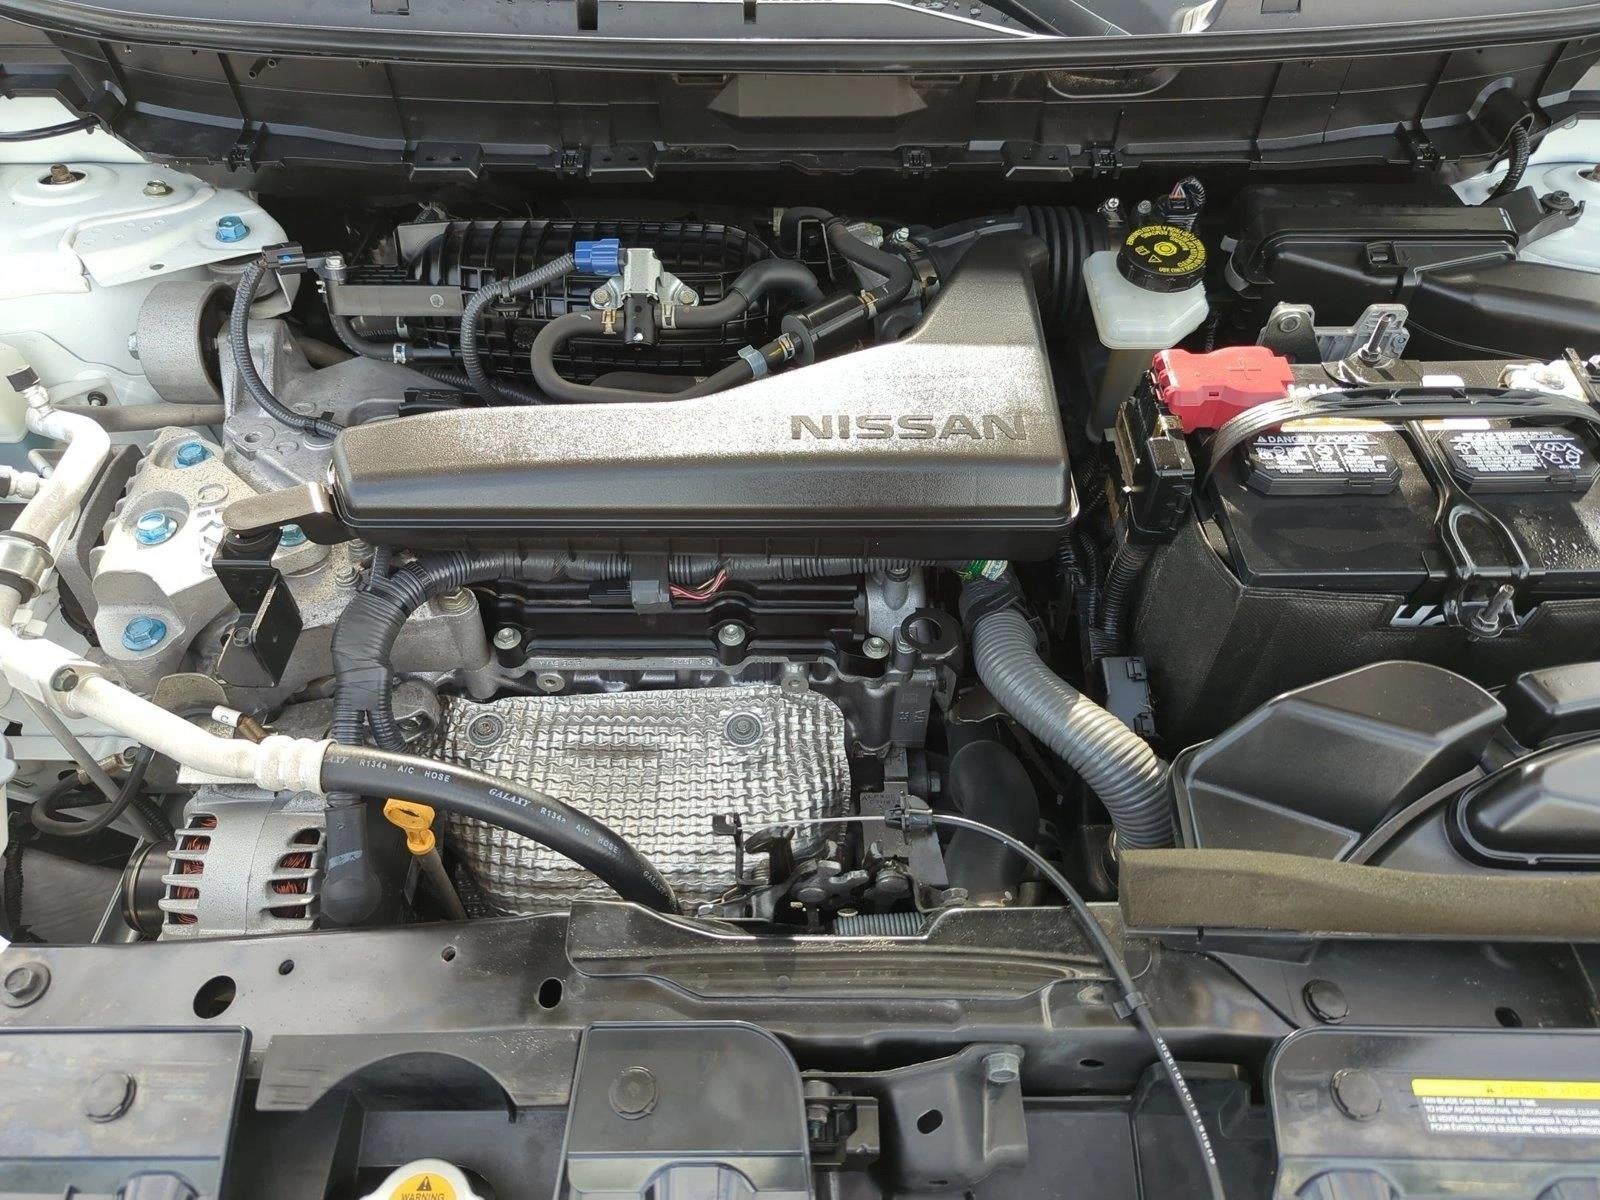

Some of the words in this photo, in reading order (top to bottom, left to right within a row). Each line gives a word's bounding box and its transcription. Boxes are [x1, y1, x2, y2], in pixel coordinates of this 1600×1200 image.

[791, 415, 1026, 440] NISSAN
[359, 758, 387, 770] R134a
[397, 763, 415, 775] A/C
[424, 770, 451, 783] HOSE
[488, 788, 532, 808] GALAXY
[540, 806, 567, 824] R134a
[575, 823, 591, 838] A/C
[598, 836, 619, 855] HOSE
